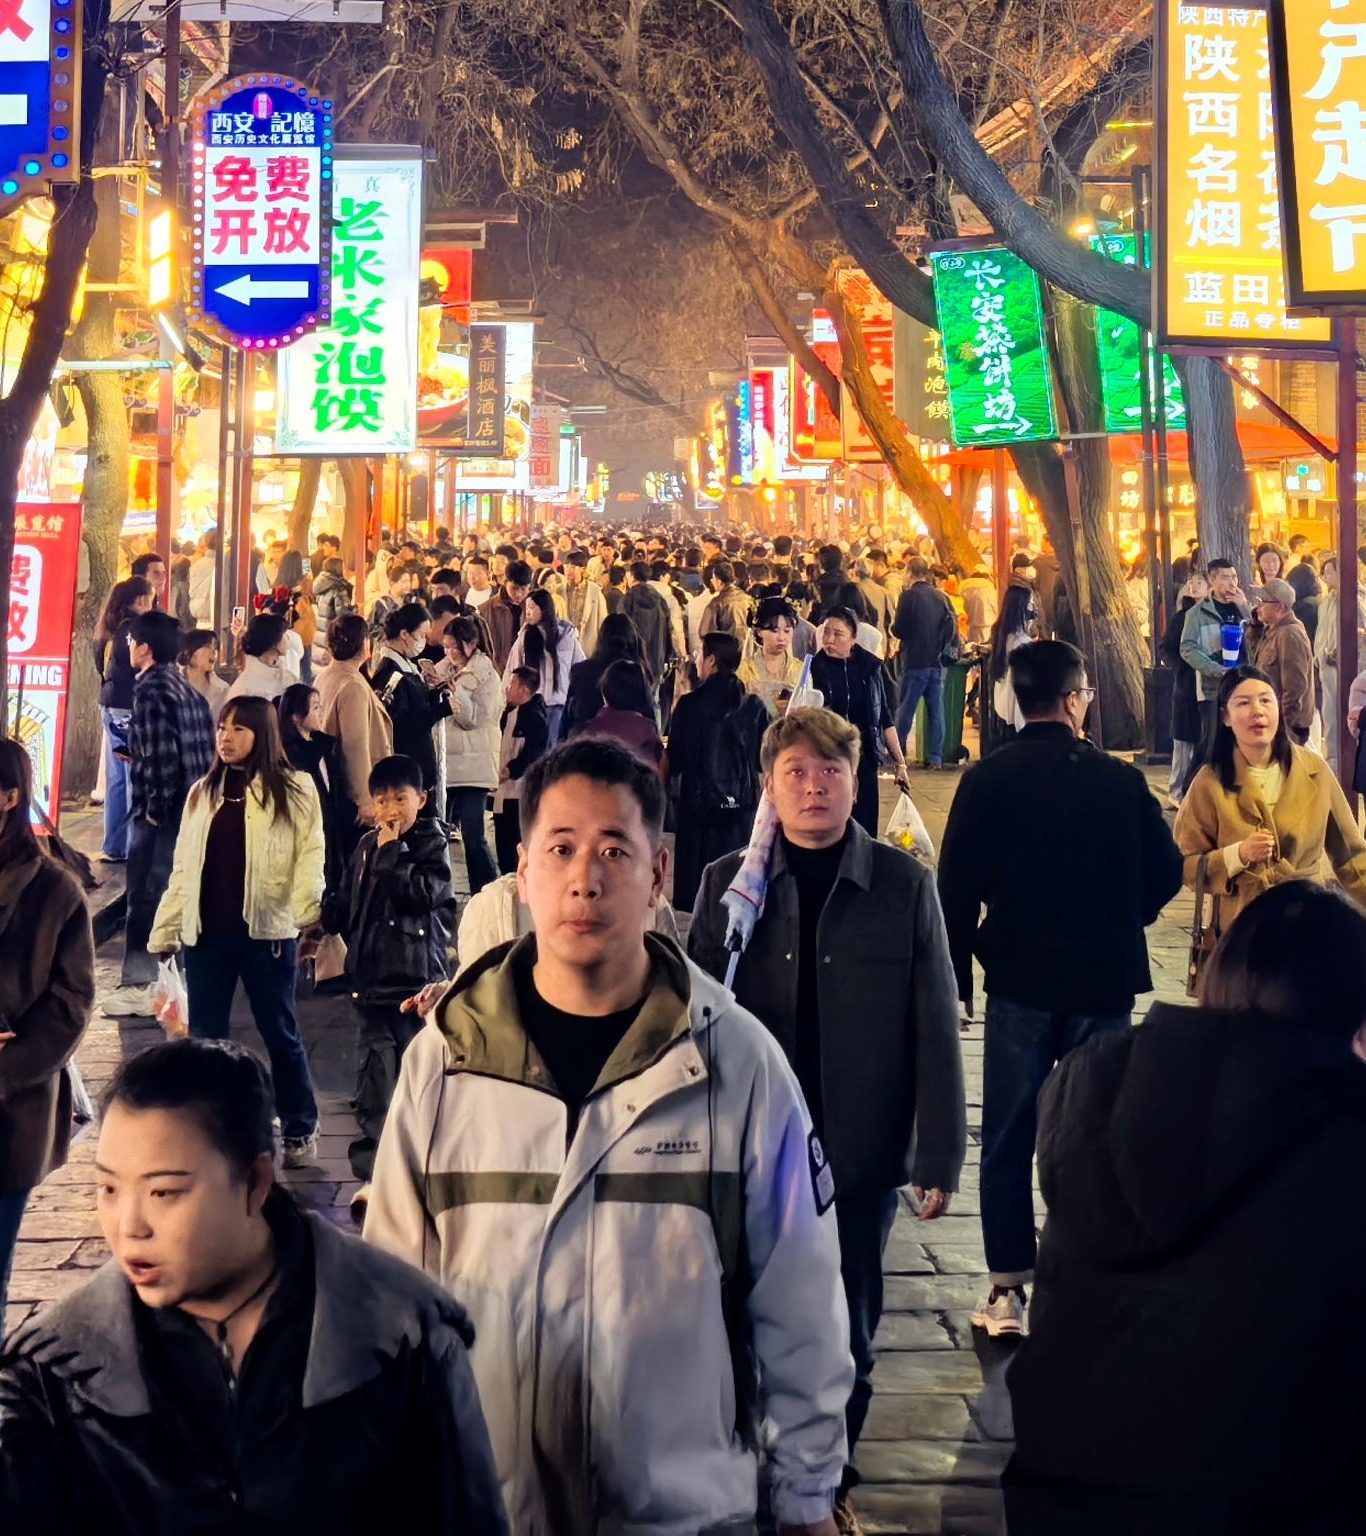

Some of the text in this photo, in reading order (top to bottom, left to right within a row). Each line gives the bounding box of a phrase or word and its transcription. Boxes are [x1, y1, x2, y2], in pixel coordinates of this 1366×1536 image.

[211, 112, 255, 133] 西安
[1183, 34, 1242, 250] 陕西名烟
[211, 155, 310, 204] 免费
[210, 208, 311, 255] 开放
[1183, 271, 1286, 305] 蓝田
[310, 197, 391, 434] 老米家泡馍
